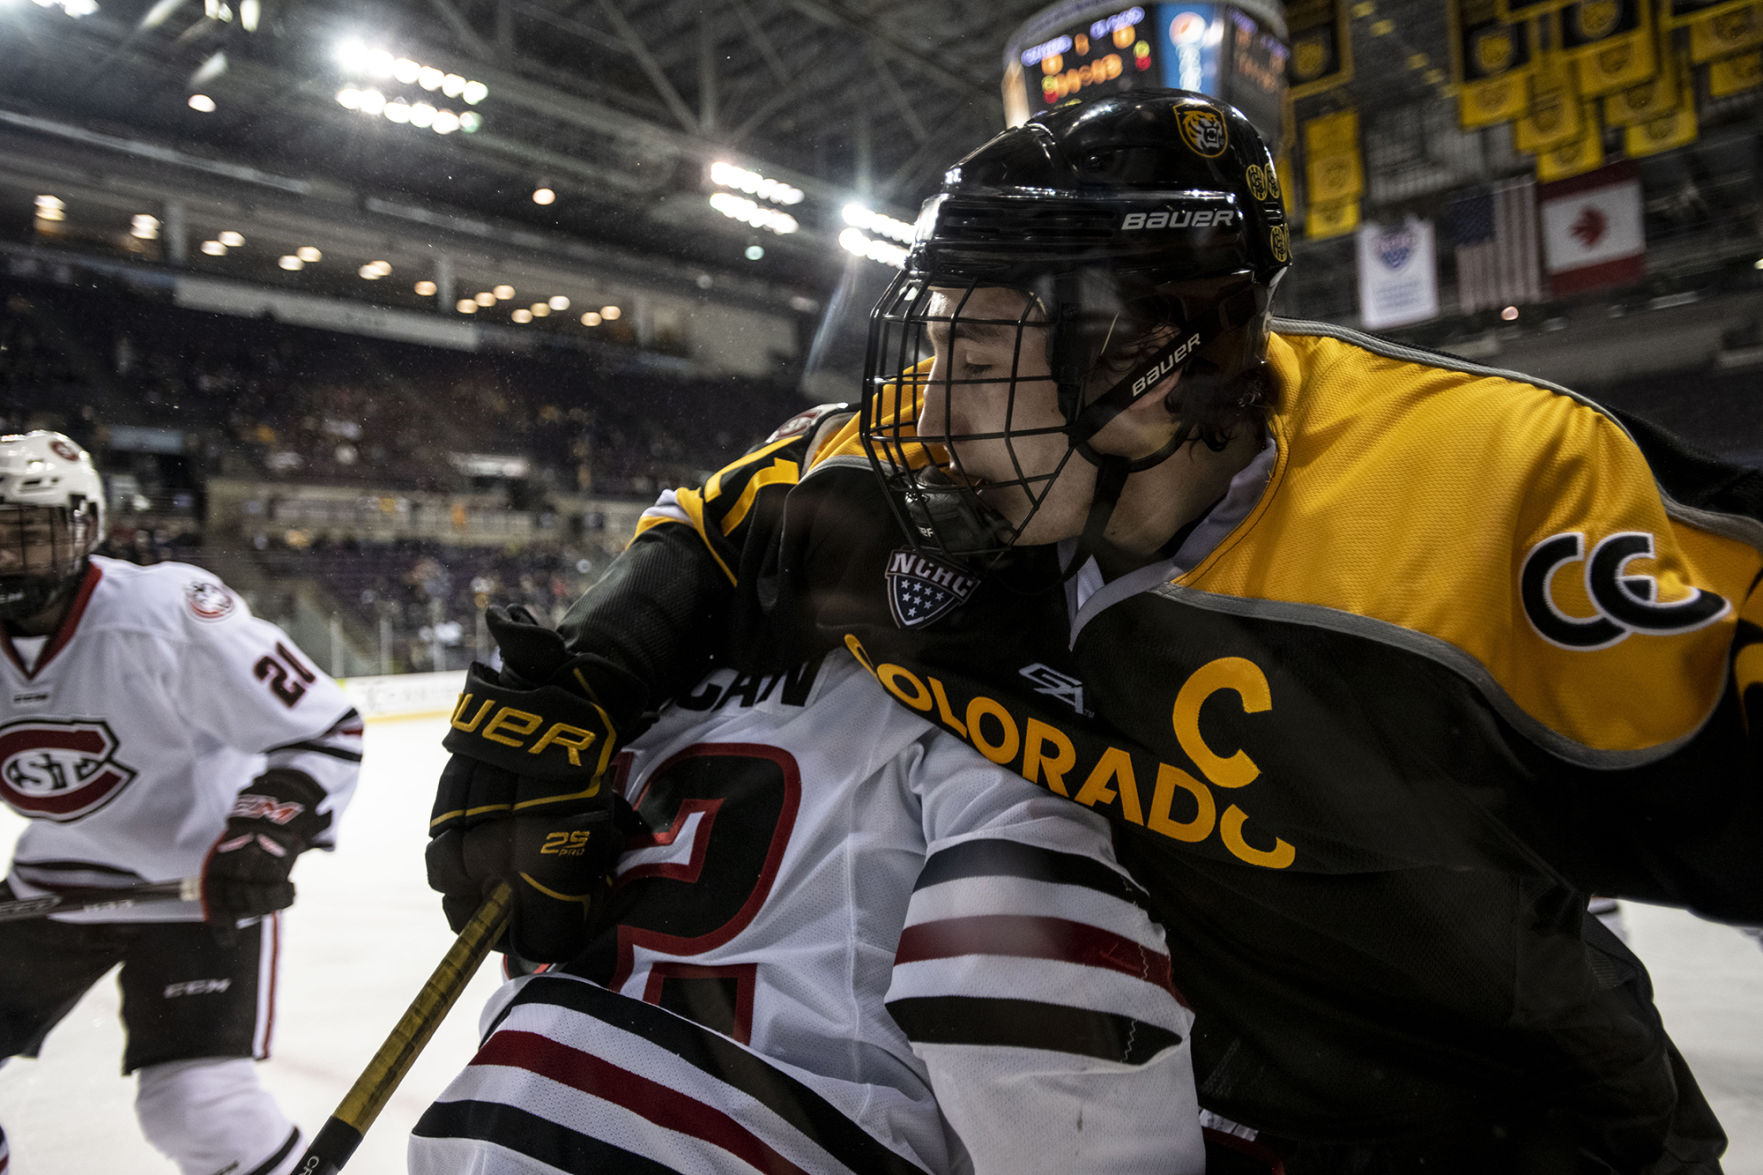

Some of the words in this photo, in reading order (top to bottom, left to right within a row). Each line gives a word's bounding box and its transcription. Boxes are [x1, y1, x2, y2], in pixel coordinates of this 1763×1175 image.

[1121, 208, 1236, 230] BAUER
[1131, 332, 1202, 398] BAUER
[890, 552, 974, 598] NCHC
[252, 640, 317, 709] 21
[450, 691, 597, 768] UER
[1172, 656, 1273, 789] C
[605, 742, 802, 1046] 2
